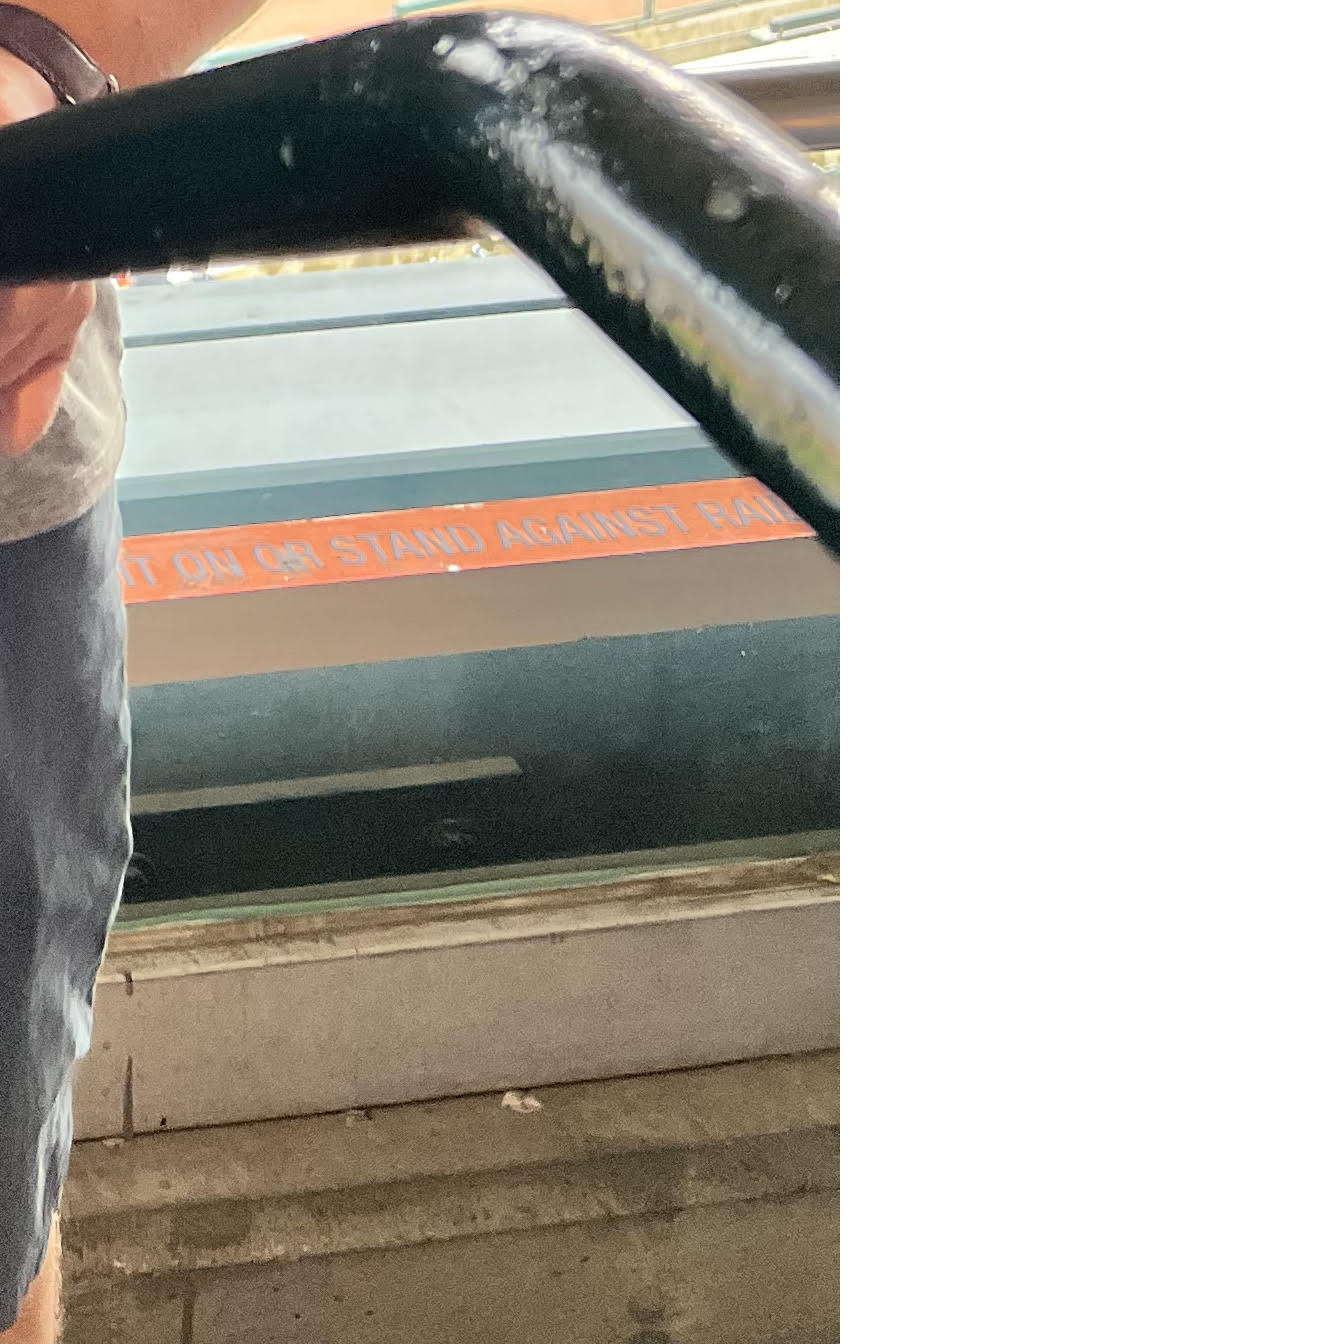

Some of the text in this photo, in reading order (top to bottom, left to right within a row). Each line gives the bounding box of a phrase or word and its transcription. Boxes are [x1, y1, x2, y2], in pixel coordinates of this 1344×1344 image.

[172, 546, 244, 583] ON
[253, 540, 326, 574] OR
[330, 524, 485, 566] STAND
[496, 504, 690, 550] AGAINST
